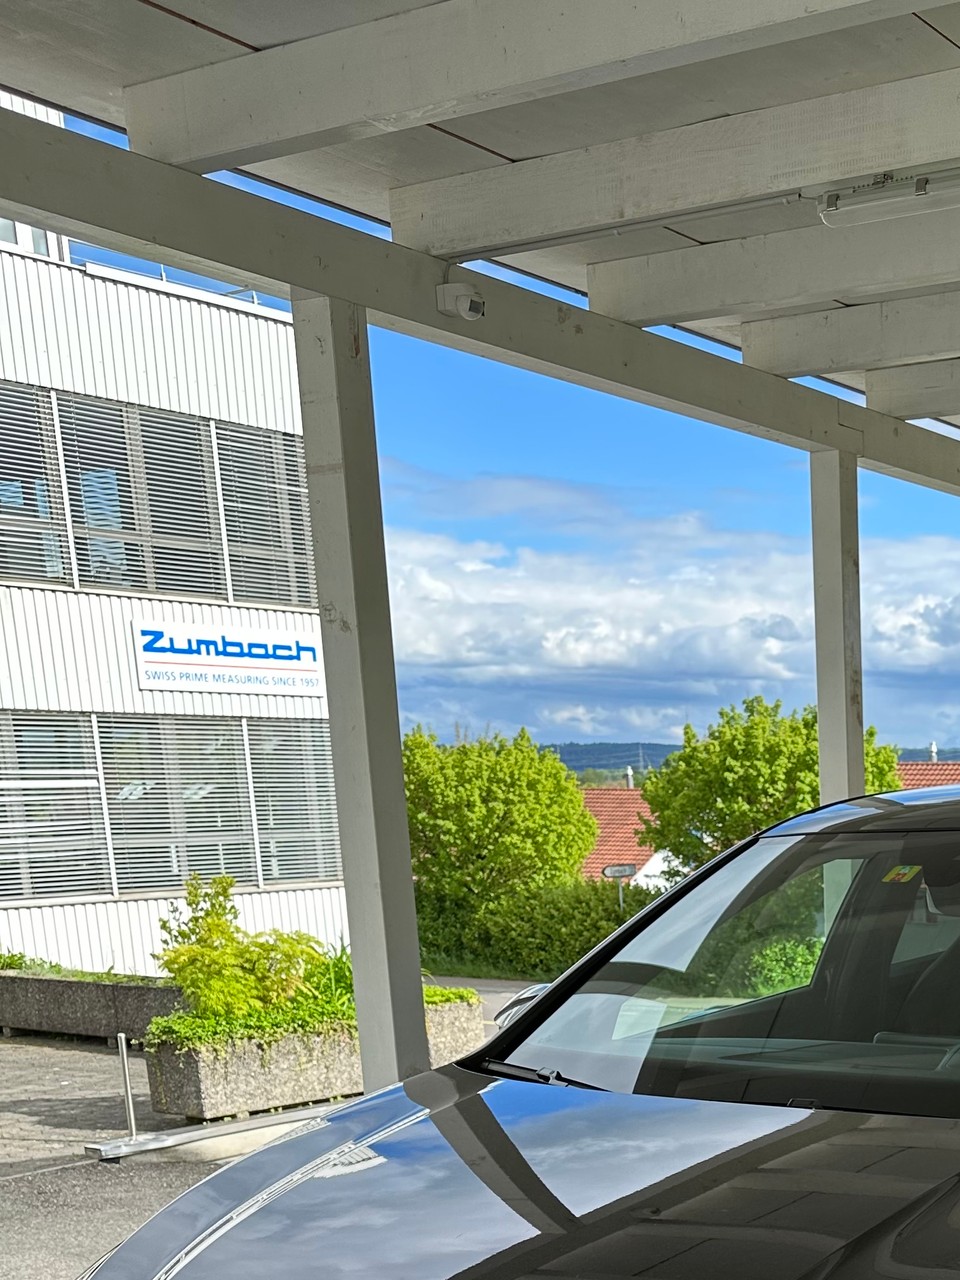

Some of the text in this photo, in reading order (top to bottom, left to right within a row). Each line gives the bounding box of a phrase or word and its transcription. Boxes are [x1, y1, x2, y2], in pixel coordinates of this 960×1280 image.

[140, 629, 317, 662] Zumbach
[144, 670, 319, 688] SWISS PRIME MEASURING SINCE 1957
